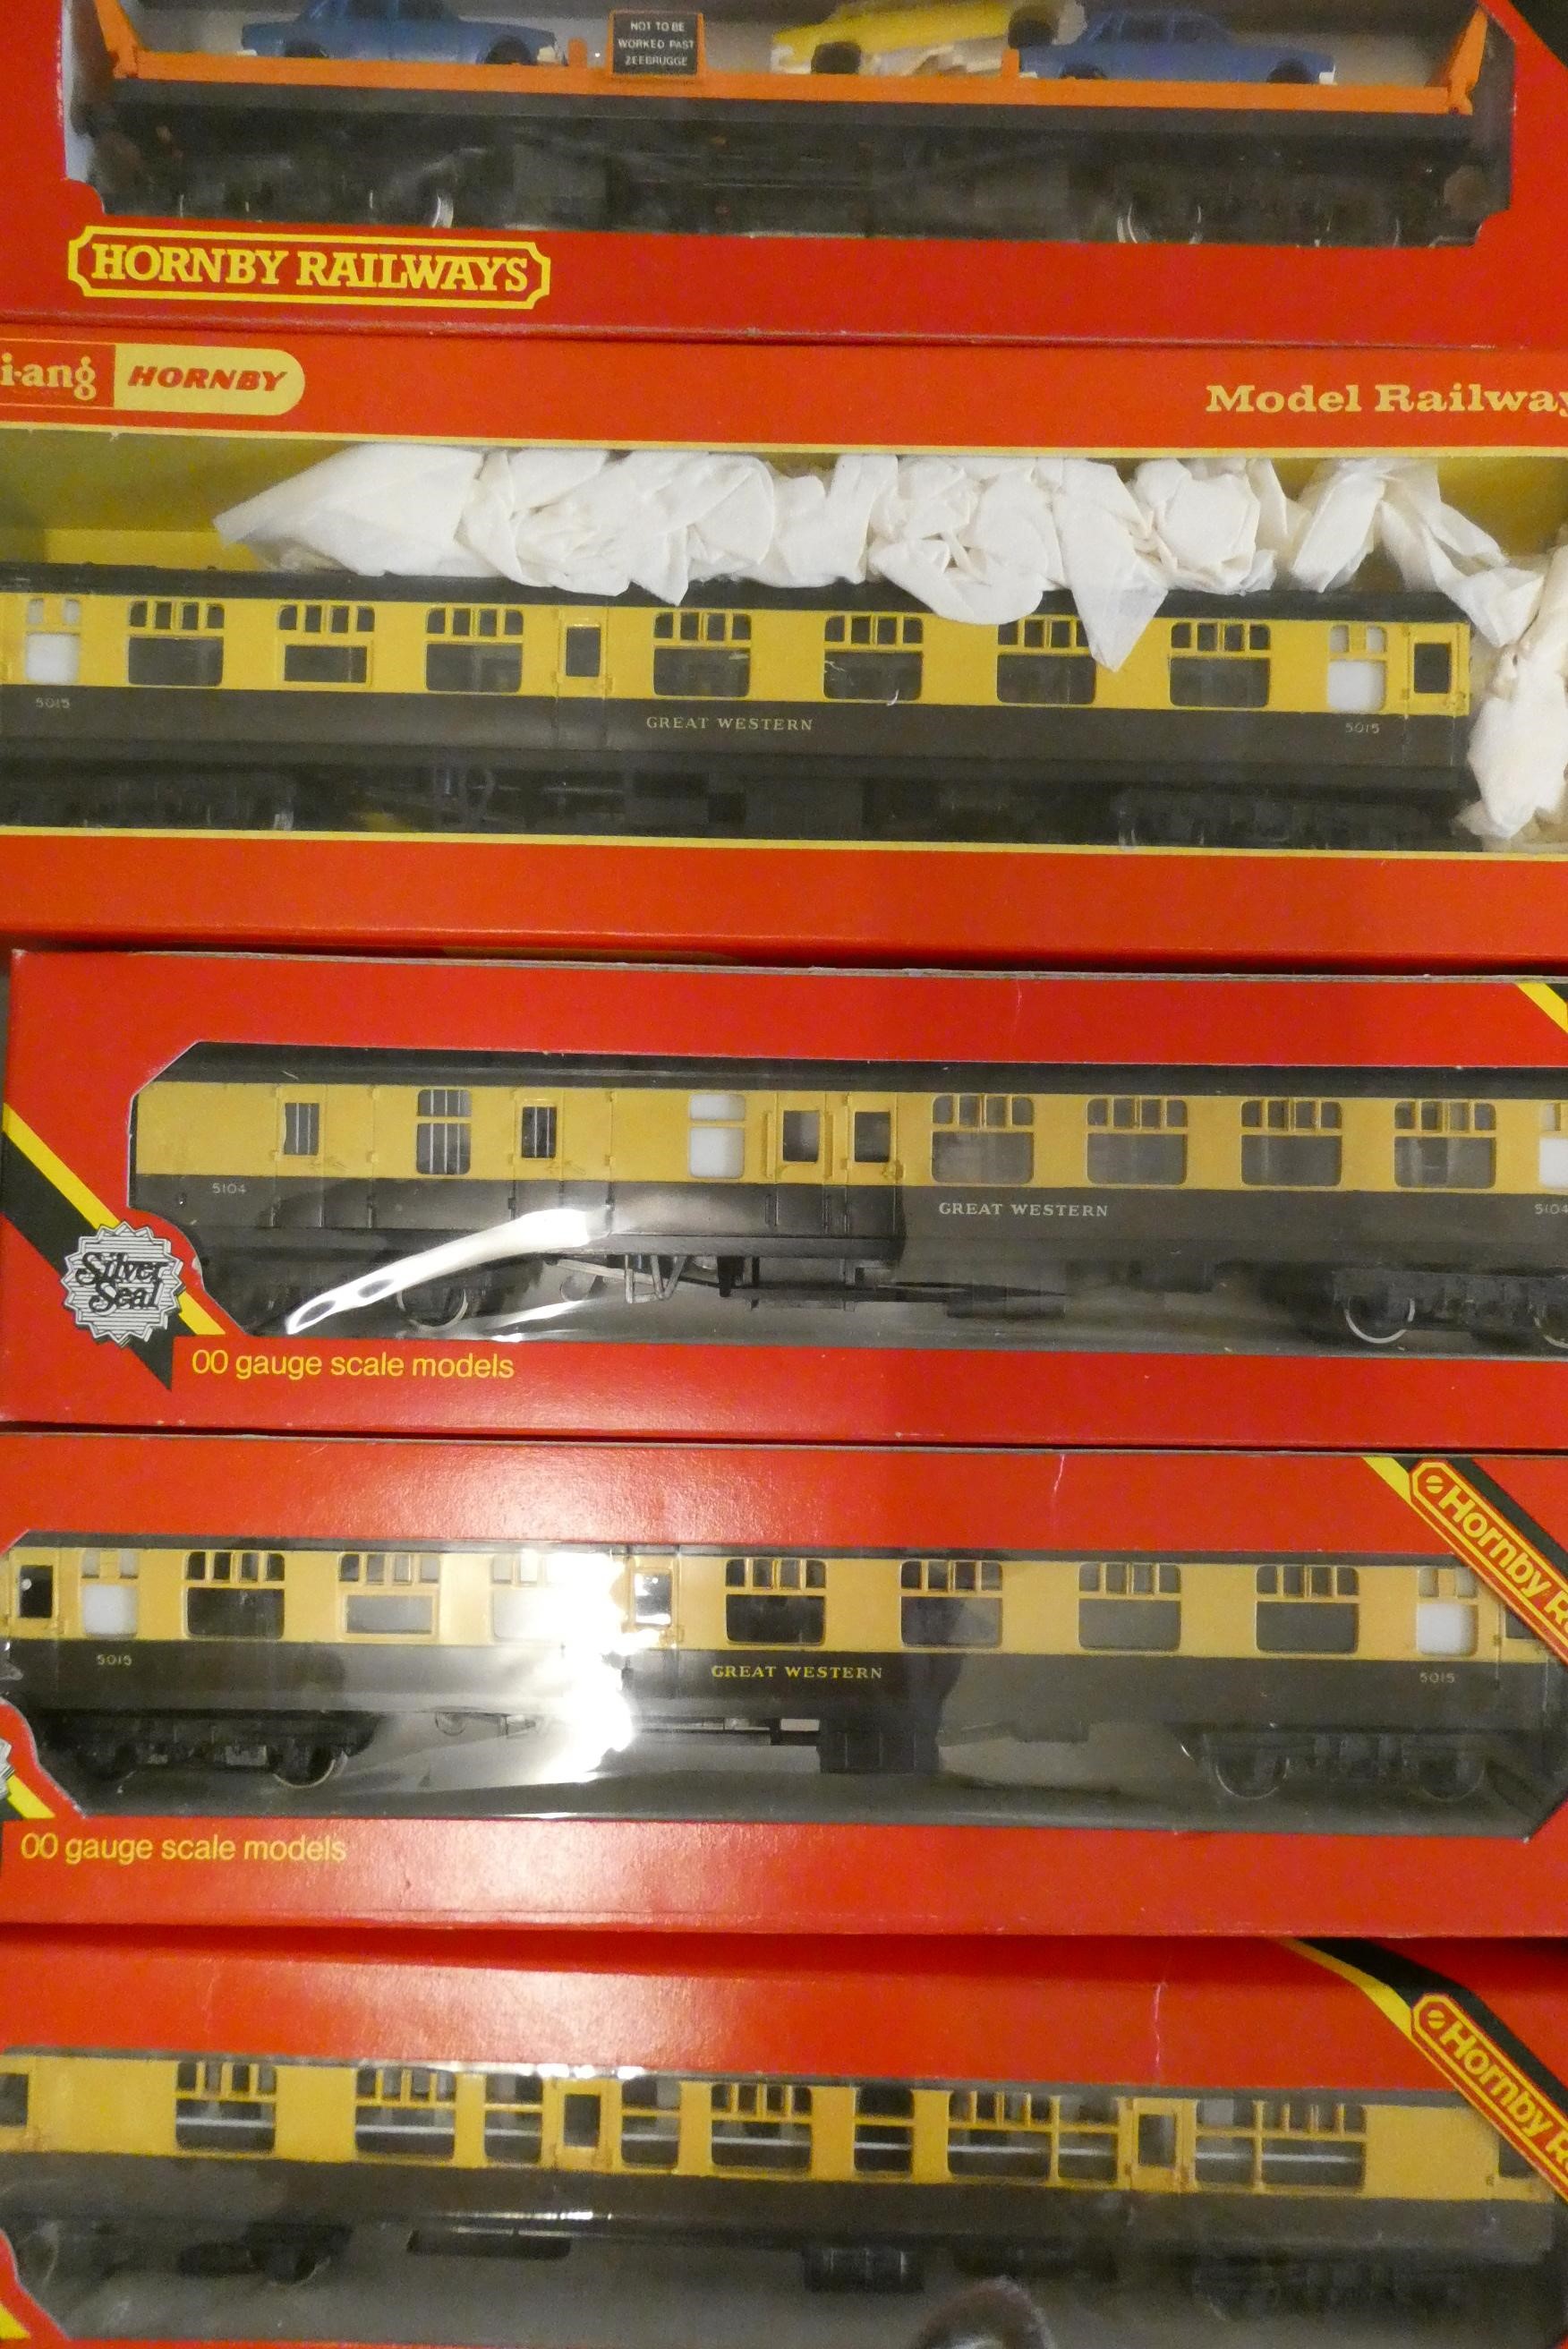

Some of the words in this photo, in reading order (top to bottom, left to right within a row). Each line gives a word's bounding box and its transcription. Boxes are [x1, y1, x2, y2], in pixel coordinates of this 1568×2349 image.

[630, 21, 651, 31] NOT
[656, 21, 670, 31] TO
[671, 21, 685, 32] BE
[618, 38, 665, 49] WORKED
[669, 39, 694, 50] PAST
[626, 56, 688, 66] ZEEBRUGGE
[91, 243, 289, 285] HORNBY
[296, 250, 528, 293] RAILWAYS
[127, 365, 287, 392] HORNBY
[1205, 384, 1362, 414] Model
[36, 696, 71, 709] 5015
[646, 716, 709, 730] GREAT
[717, 717, 814, 731] WESTERN
[1345, 722, 1380, 734] 5015
[212, 1182, 246, 1194] 5104
[939, 1202, 1002, 1216] GREAT
[1010, 1203, 1108, 1217] WESTERN
[75, 1251, 170, 1286] Silver
[89, 1275, 161, 1313] Seal
[235, 1353, 322, 1380] gauge
[330, 1352, 404, 1377] scale
[413, 1353, 515, 1380] models
[1438, 1484, 1552, 1597] Hornby
[97, 1654, 132, 1666] 5015
[711, 1665, 776, 1678] GREAT
[784, 1666, 882, 1679] WESTERN
[1419, 1671, 1455, 1684] 5015
[65, 1838, 153, 1866] gauge
[162, 1833, 235, 1859] scale
[243, 1833, 346, 1862] models
[1439, 2020, 1553, 2138] Hornby
